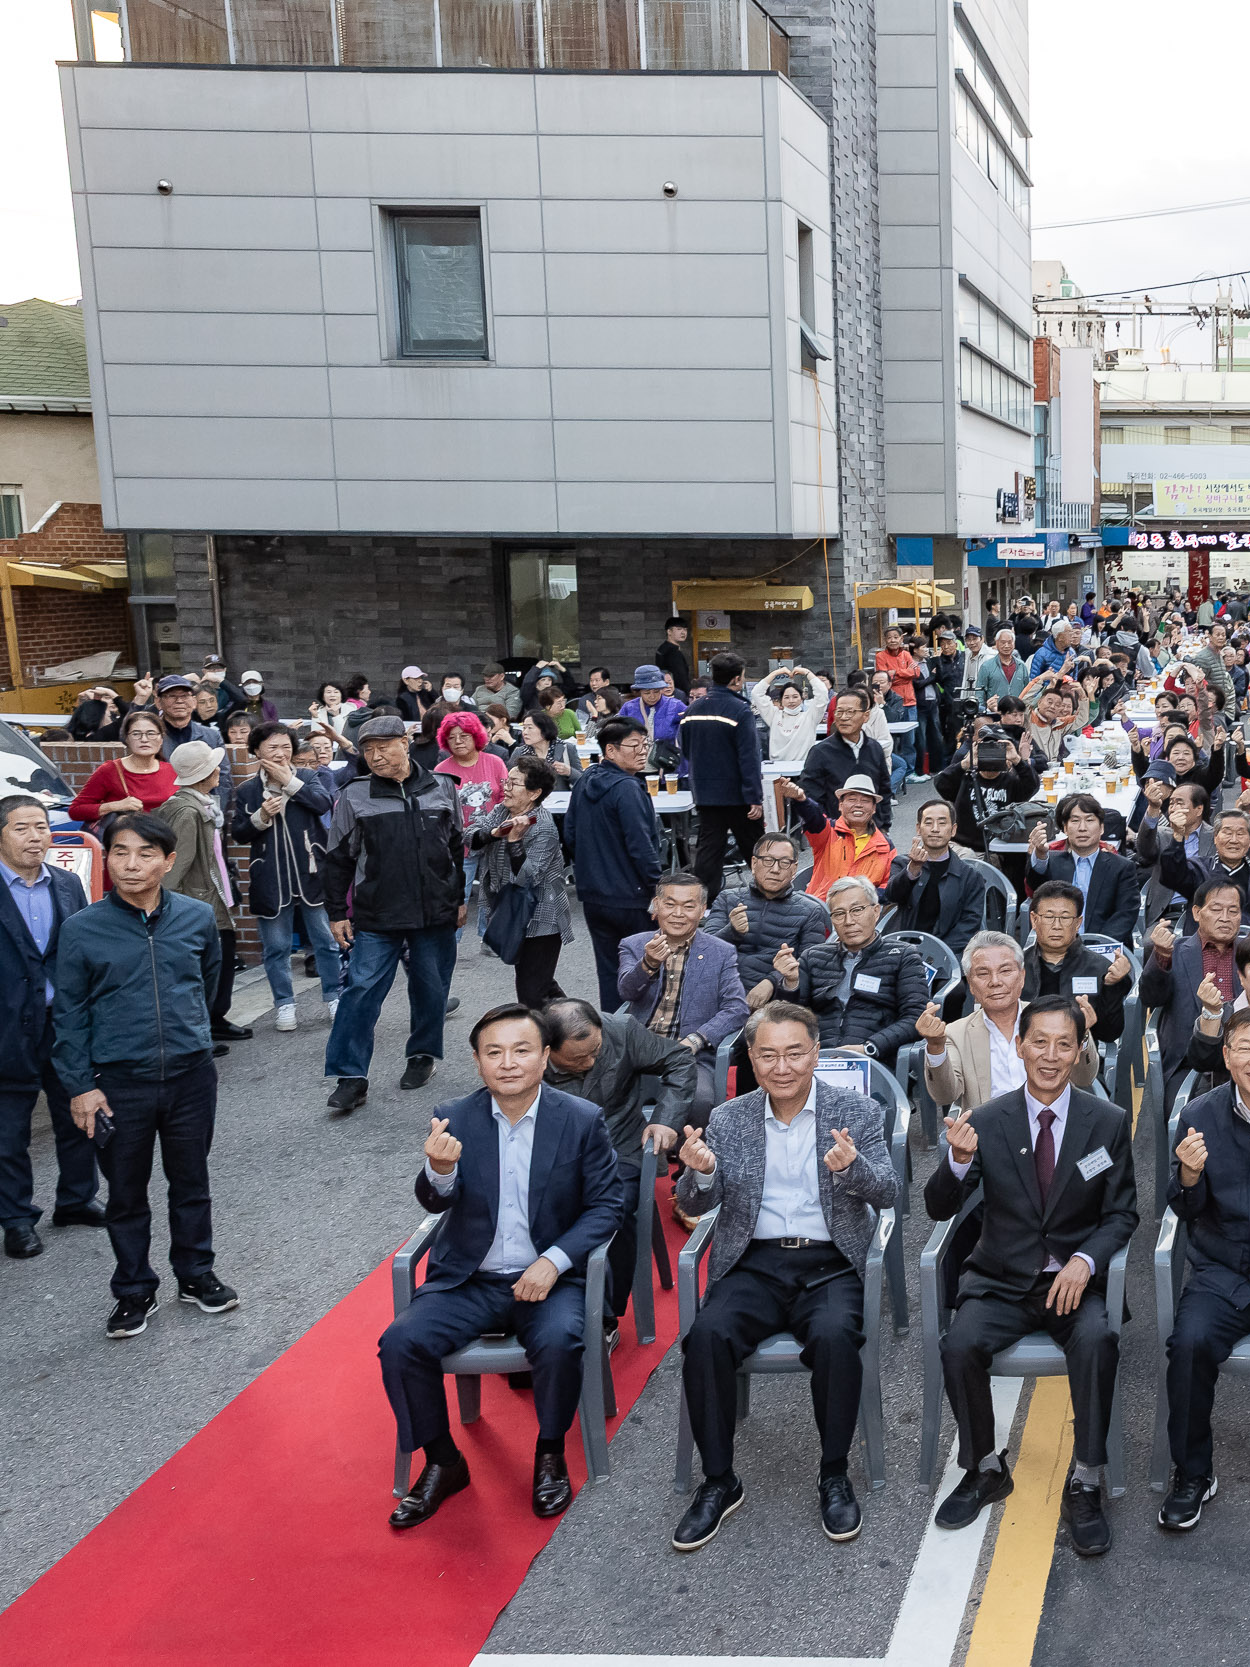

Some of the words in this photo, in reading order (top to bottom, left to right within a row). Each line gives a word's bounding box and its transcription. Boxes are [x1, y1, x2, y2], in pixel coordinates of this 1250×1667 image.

[1160, 472, 1207, 480] 02-466-5003
[1205, 483, 1246, 493] 시장에서도
[1205, 494, 1244, 504] 장바구니를
